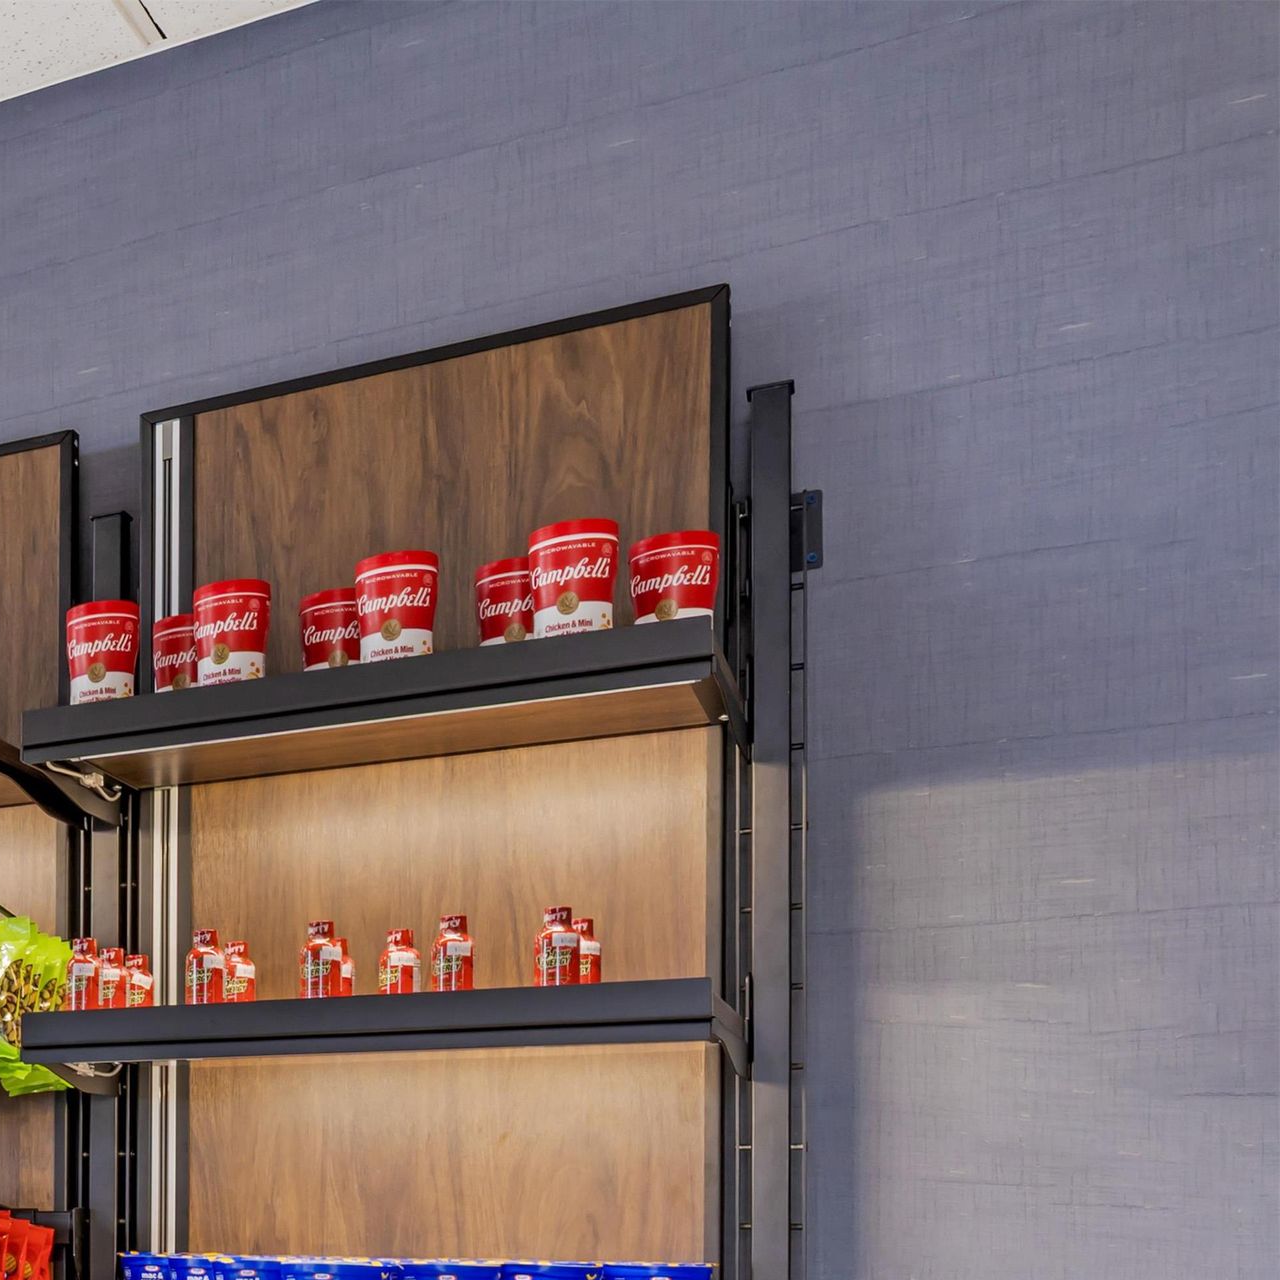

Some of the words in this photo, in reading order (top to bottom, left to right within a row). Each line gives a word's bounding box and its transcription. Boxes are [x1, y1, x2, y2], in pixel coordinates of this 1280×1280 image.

[540, 542, 596, 556] MICROWAVABLE
[530, 557, 611, 590] Campbell's
[631, 566, 711, 598] Campbell's
[357, 587, 431, 617] Campbell's
[194, 612, 258, 641] Campbell's
[545, 621, 570, 634] Chicken
[578, 618, 593, 628] Mini
[68, 633, 133, 660] Campbell's
[370, 647, 393, 658] Chicken
[400, 644, 414, 653] Mini
[157, 1272, 164, 1280] &
